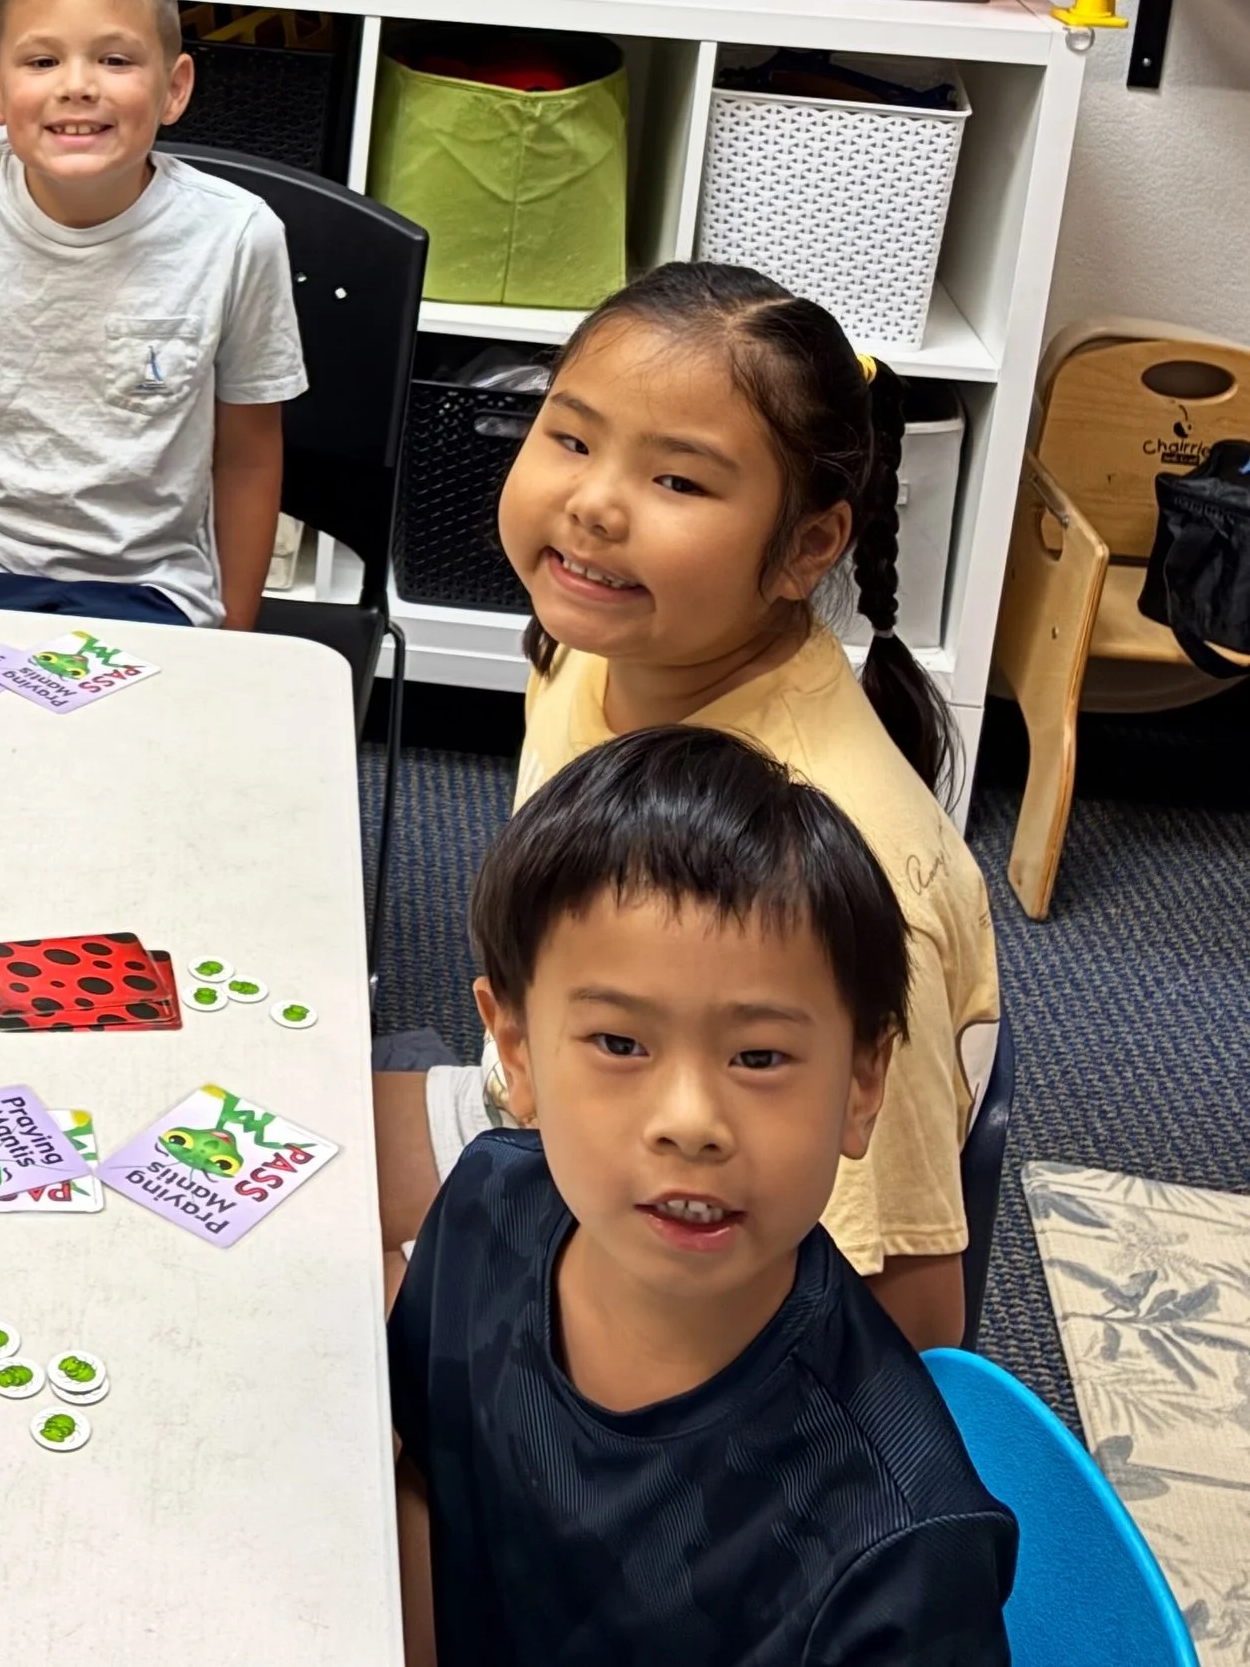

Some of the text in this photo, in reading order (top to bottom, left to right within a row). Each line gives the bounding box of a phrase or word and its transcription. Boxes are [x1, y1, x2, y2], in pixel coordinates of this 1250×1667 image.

[1, 670, 69, 708] Praying
[19, 666, 79, 698] Mantis
[77, 663, 143, 695] PASS
[0, 1095, 64, 1166] Praying
[124, 1168, 231, 1236] Praying
[146, 1160, 238, 1217] Mantis
[234, 1142, 316, 1205] PASS
